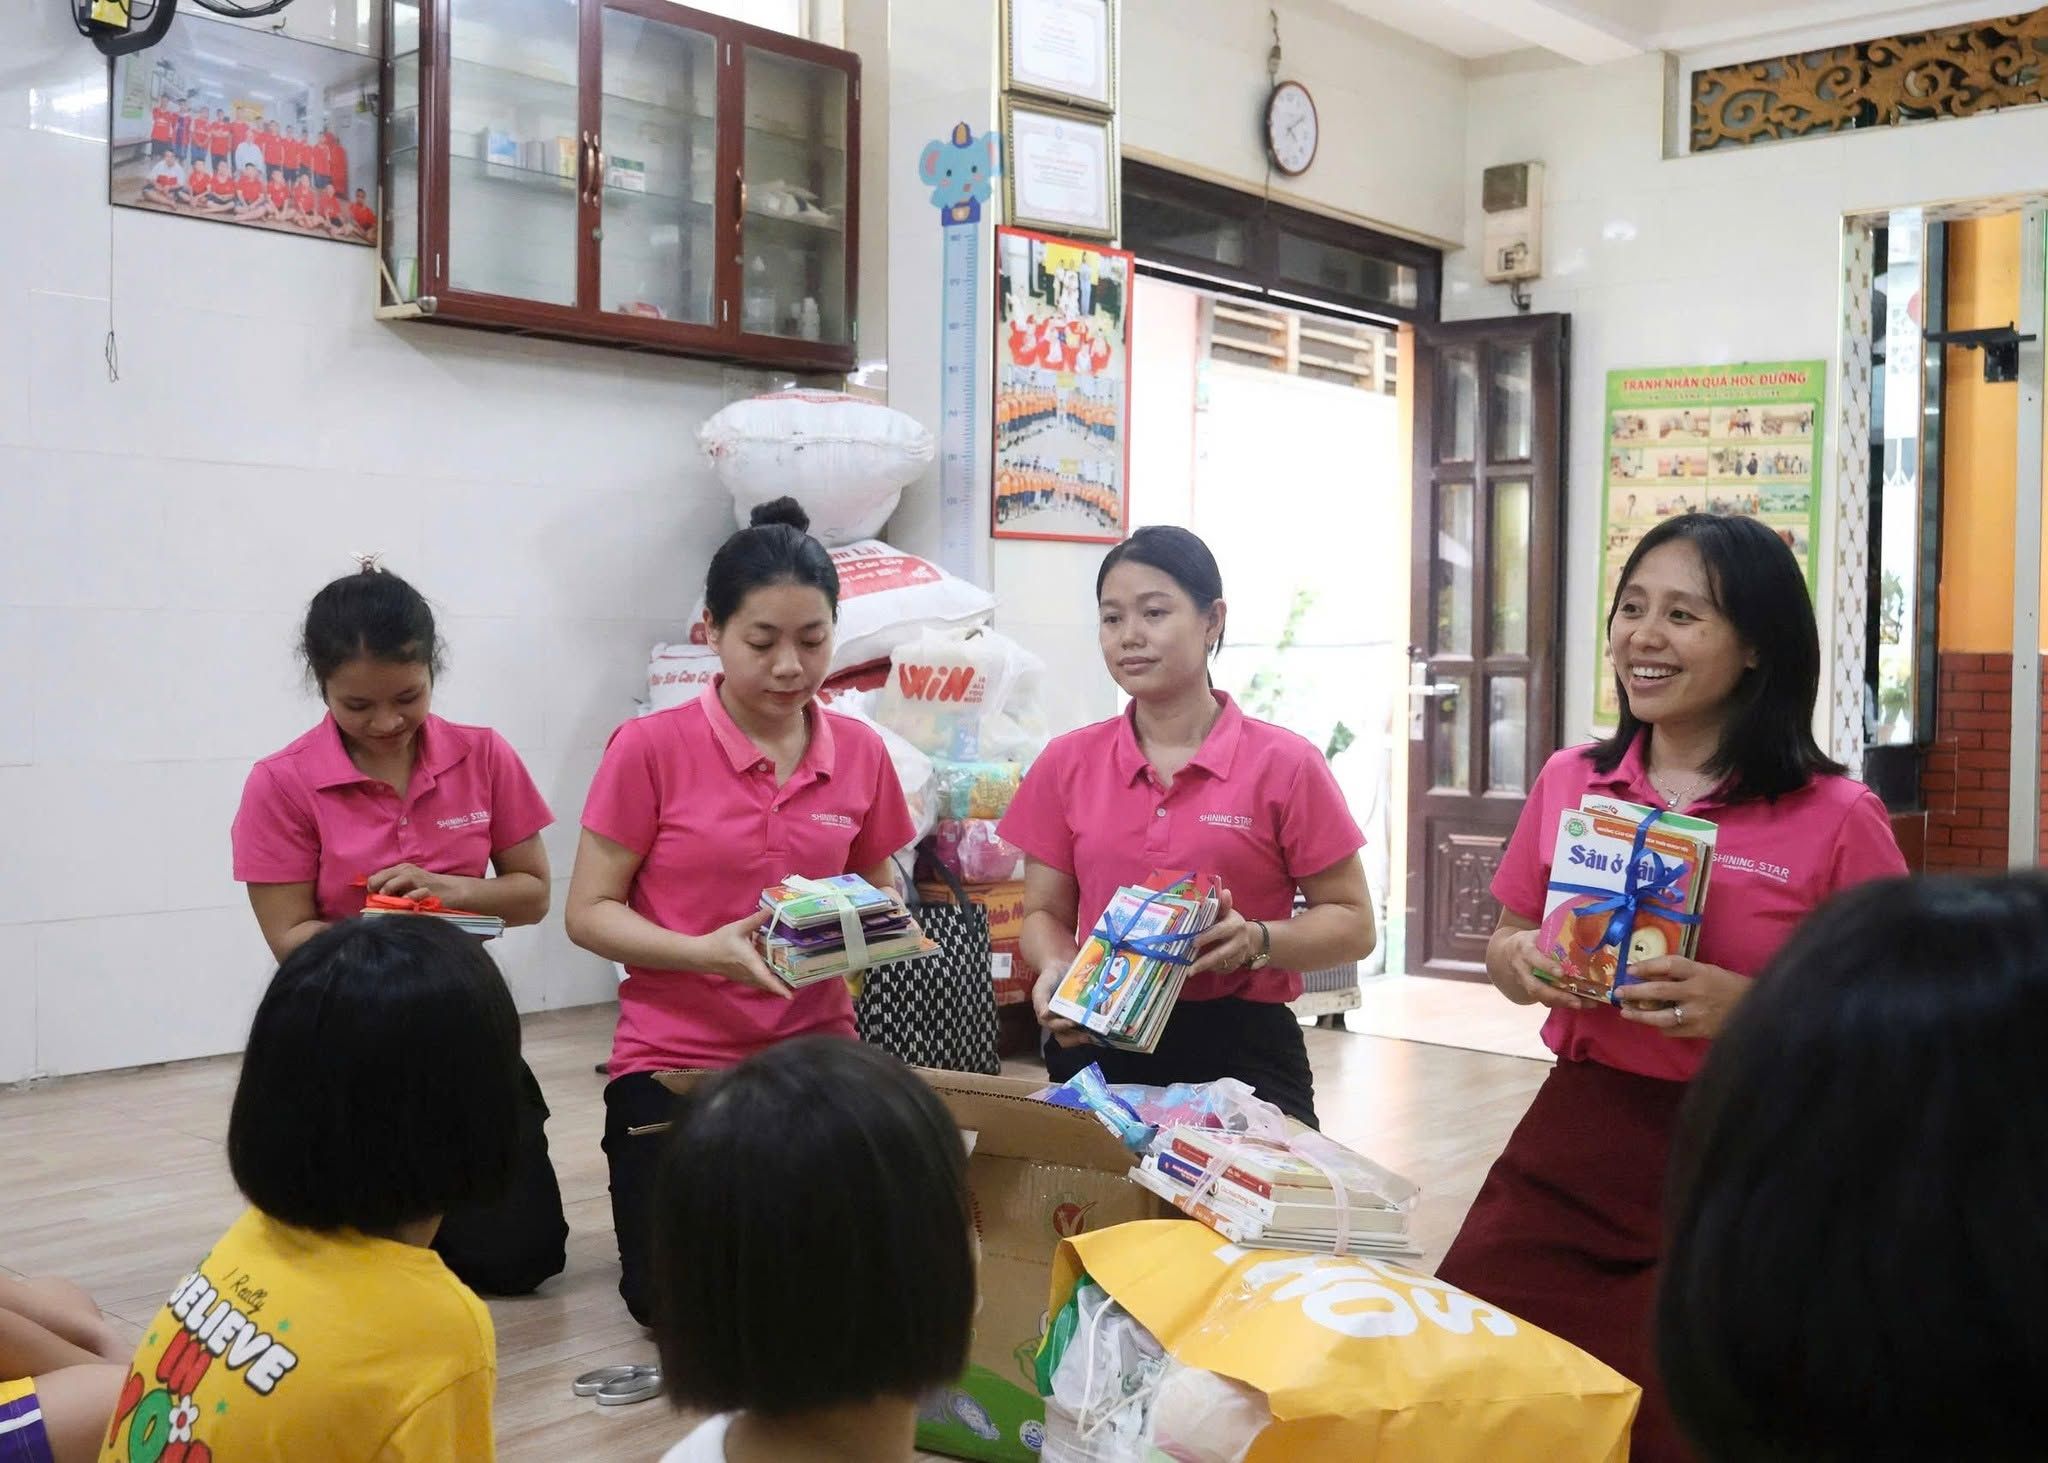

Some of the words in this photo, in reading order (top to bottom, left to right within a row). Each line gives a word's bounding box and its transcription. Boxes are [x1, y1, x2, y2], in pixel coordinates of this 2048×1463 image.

[1199, 814, 1232, 824] SHINING
[1568, 844, 1607, 872] Sâu
[1610, 853, 1624, 874] ở
[1712, 853, 1755, 868] SHINING
[1759, 861, 1790, 879] STAR
[230, 1273, 269, 1316] Really
[166, 1270, 299, 1397] BELIEVE
